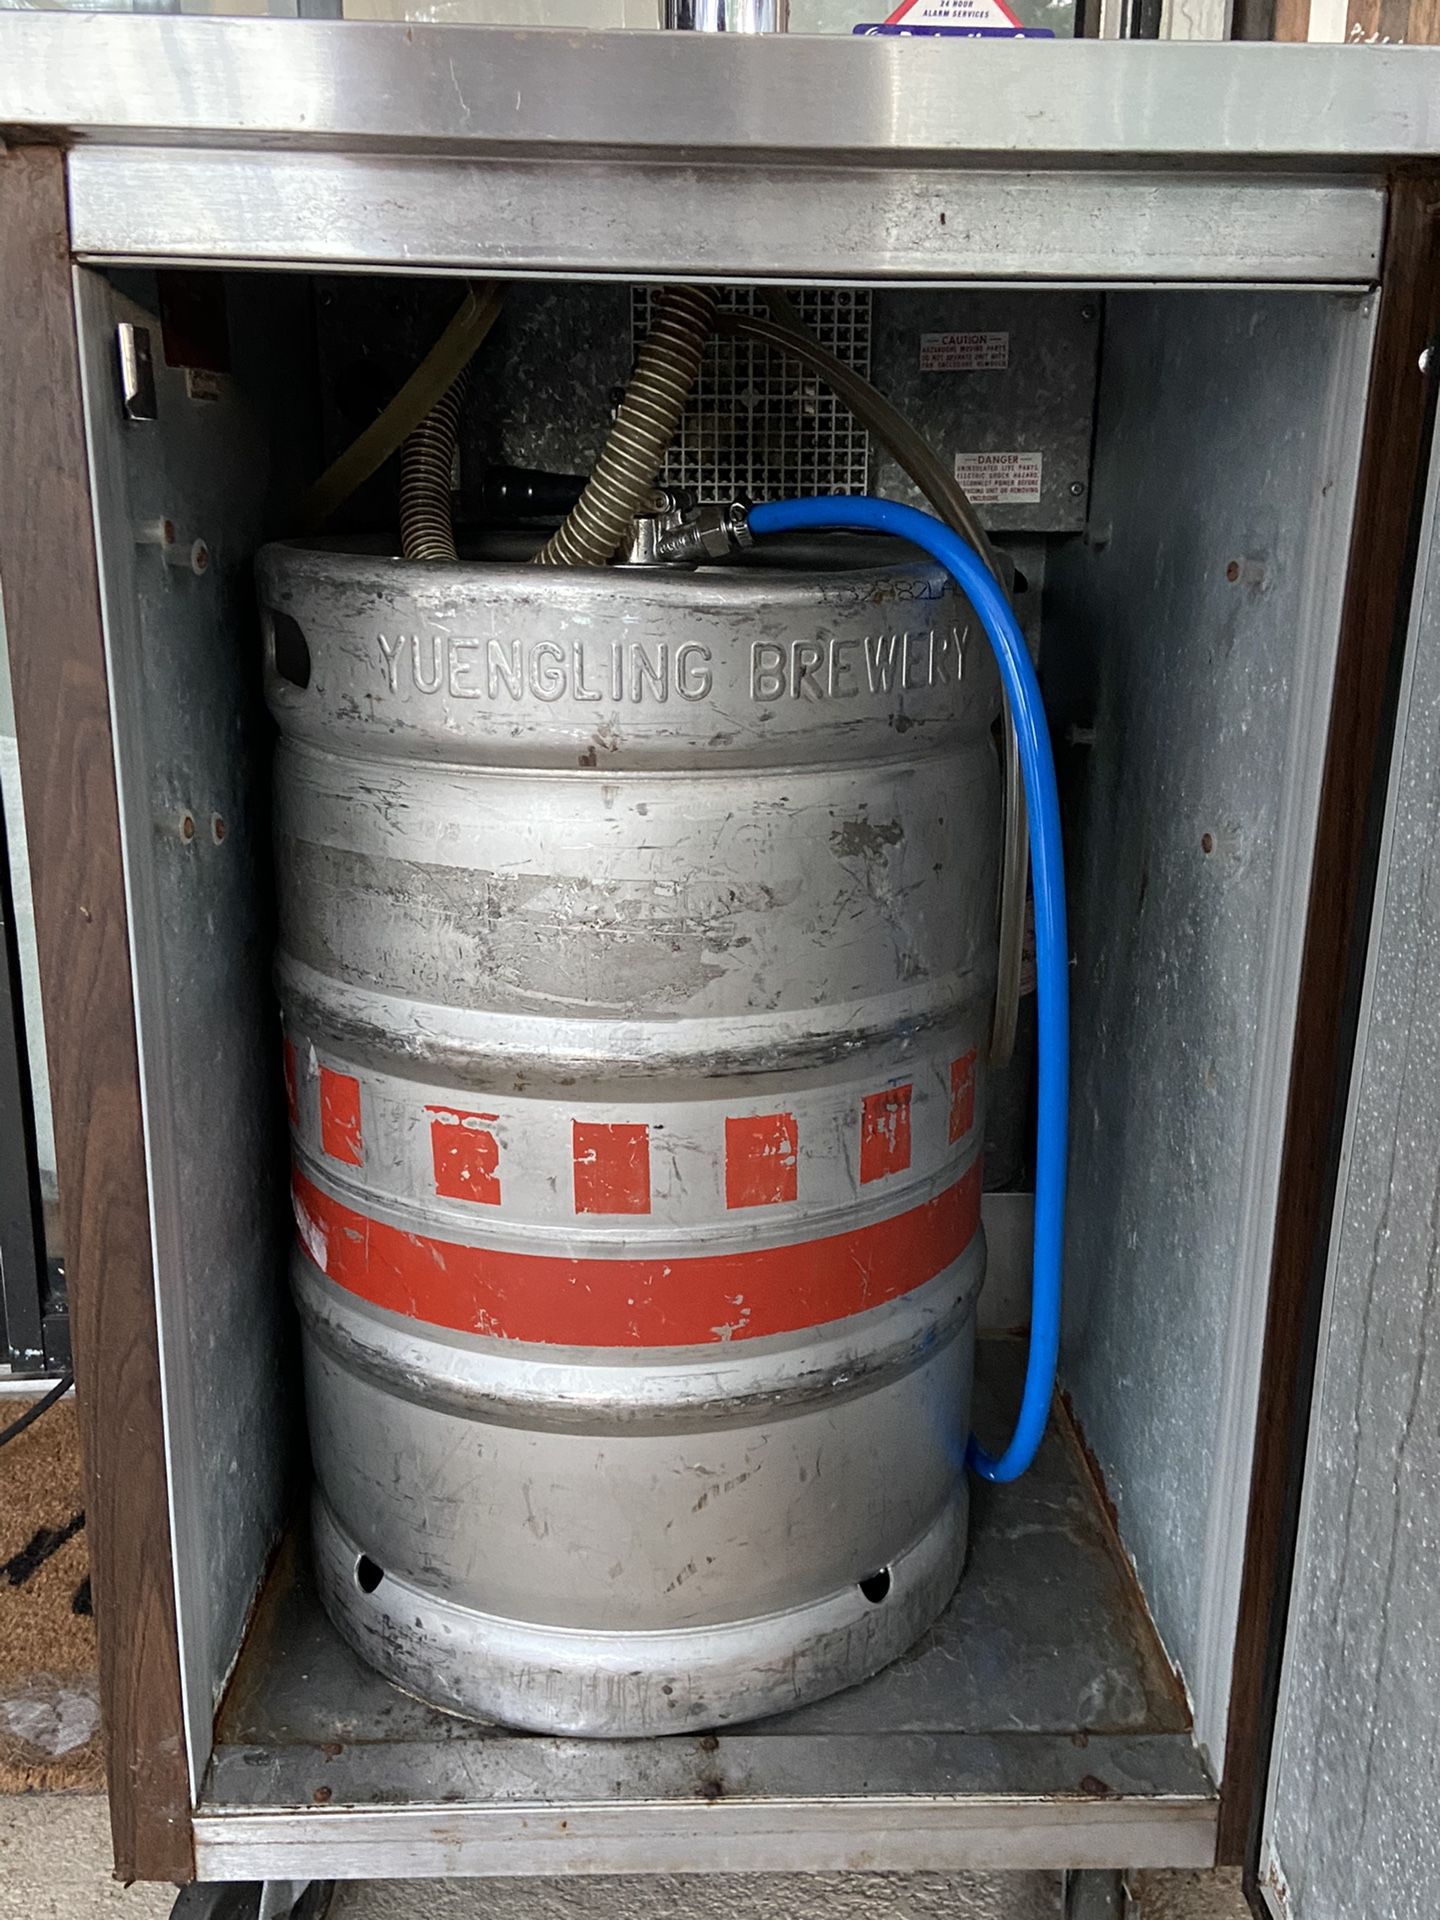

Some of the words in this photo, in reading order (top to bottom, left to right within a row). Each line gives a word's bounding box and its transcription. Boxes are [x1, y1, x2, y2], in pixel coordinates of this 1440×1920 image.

[940, 0, 950, 8] 24
[953, 0, 974, 8] HOUR
[922, 9, 950, 17] ALARM
[952, 10, 990, 19] SERVICES
[941, 335, 988, 345] CAUTION
[977, 455, 1019, 464] DANGER
[376, 631, 713, 703] YUENGLING
[750, 625, 970, 703] BREWERY
